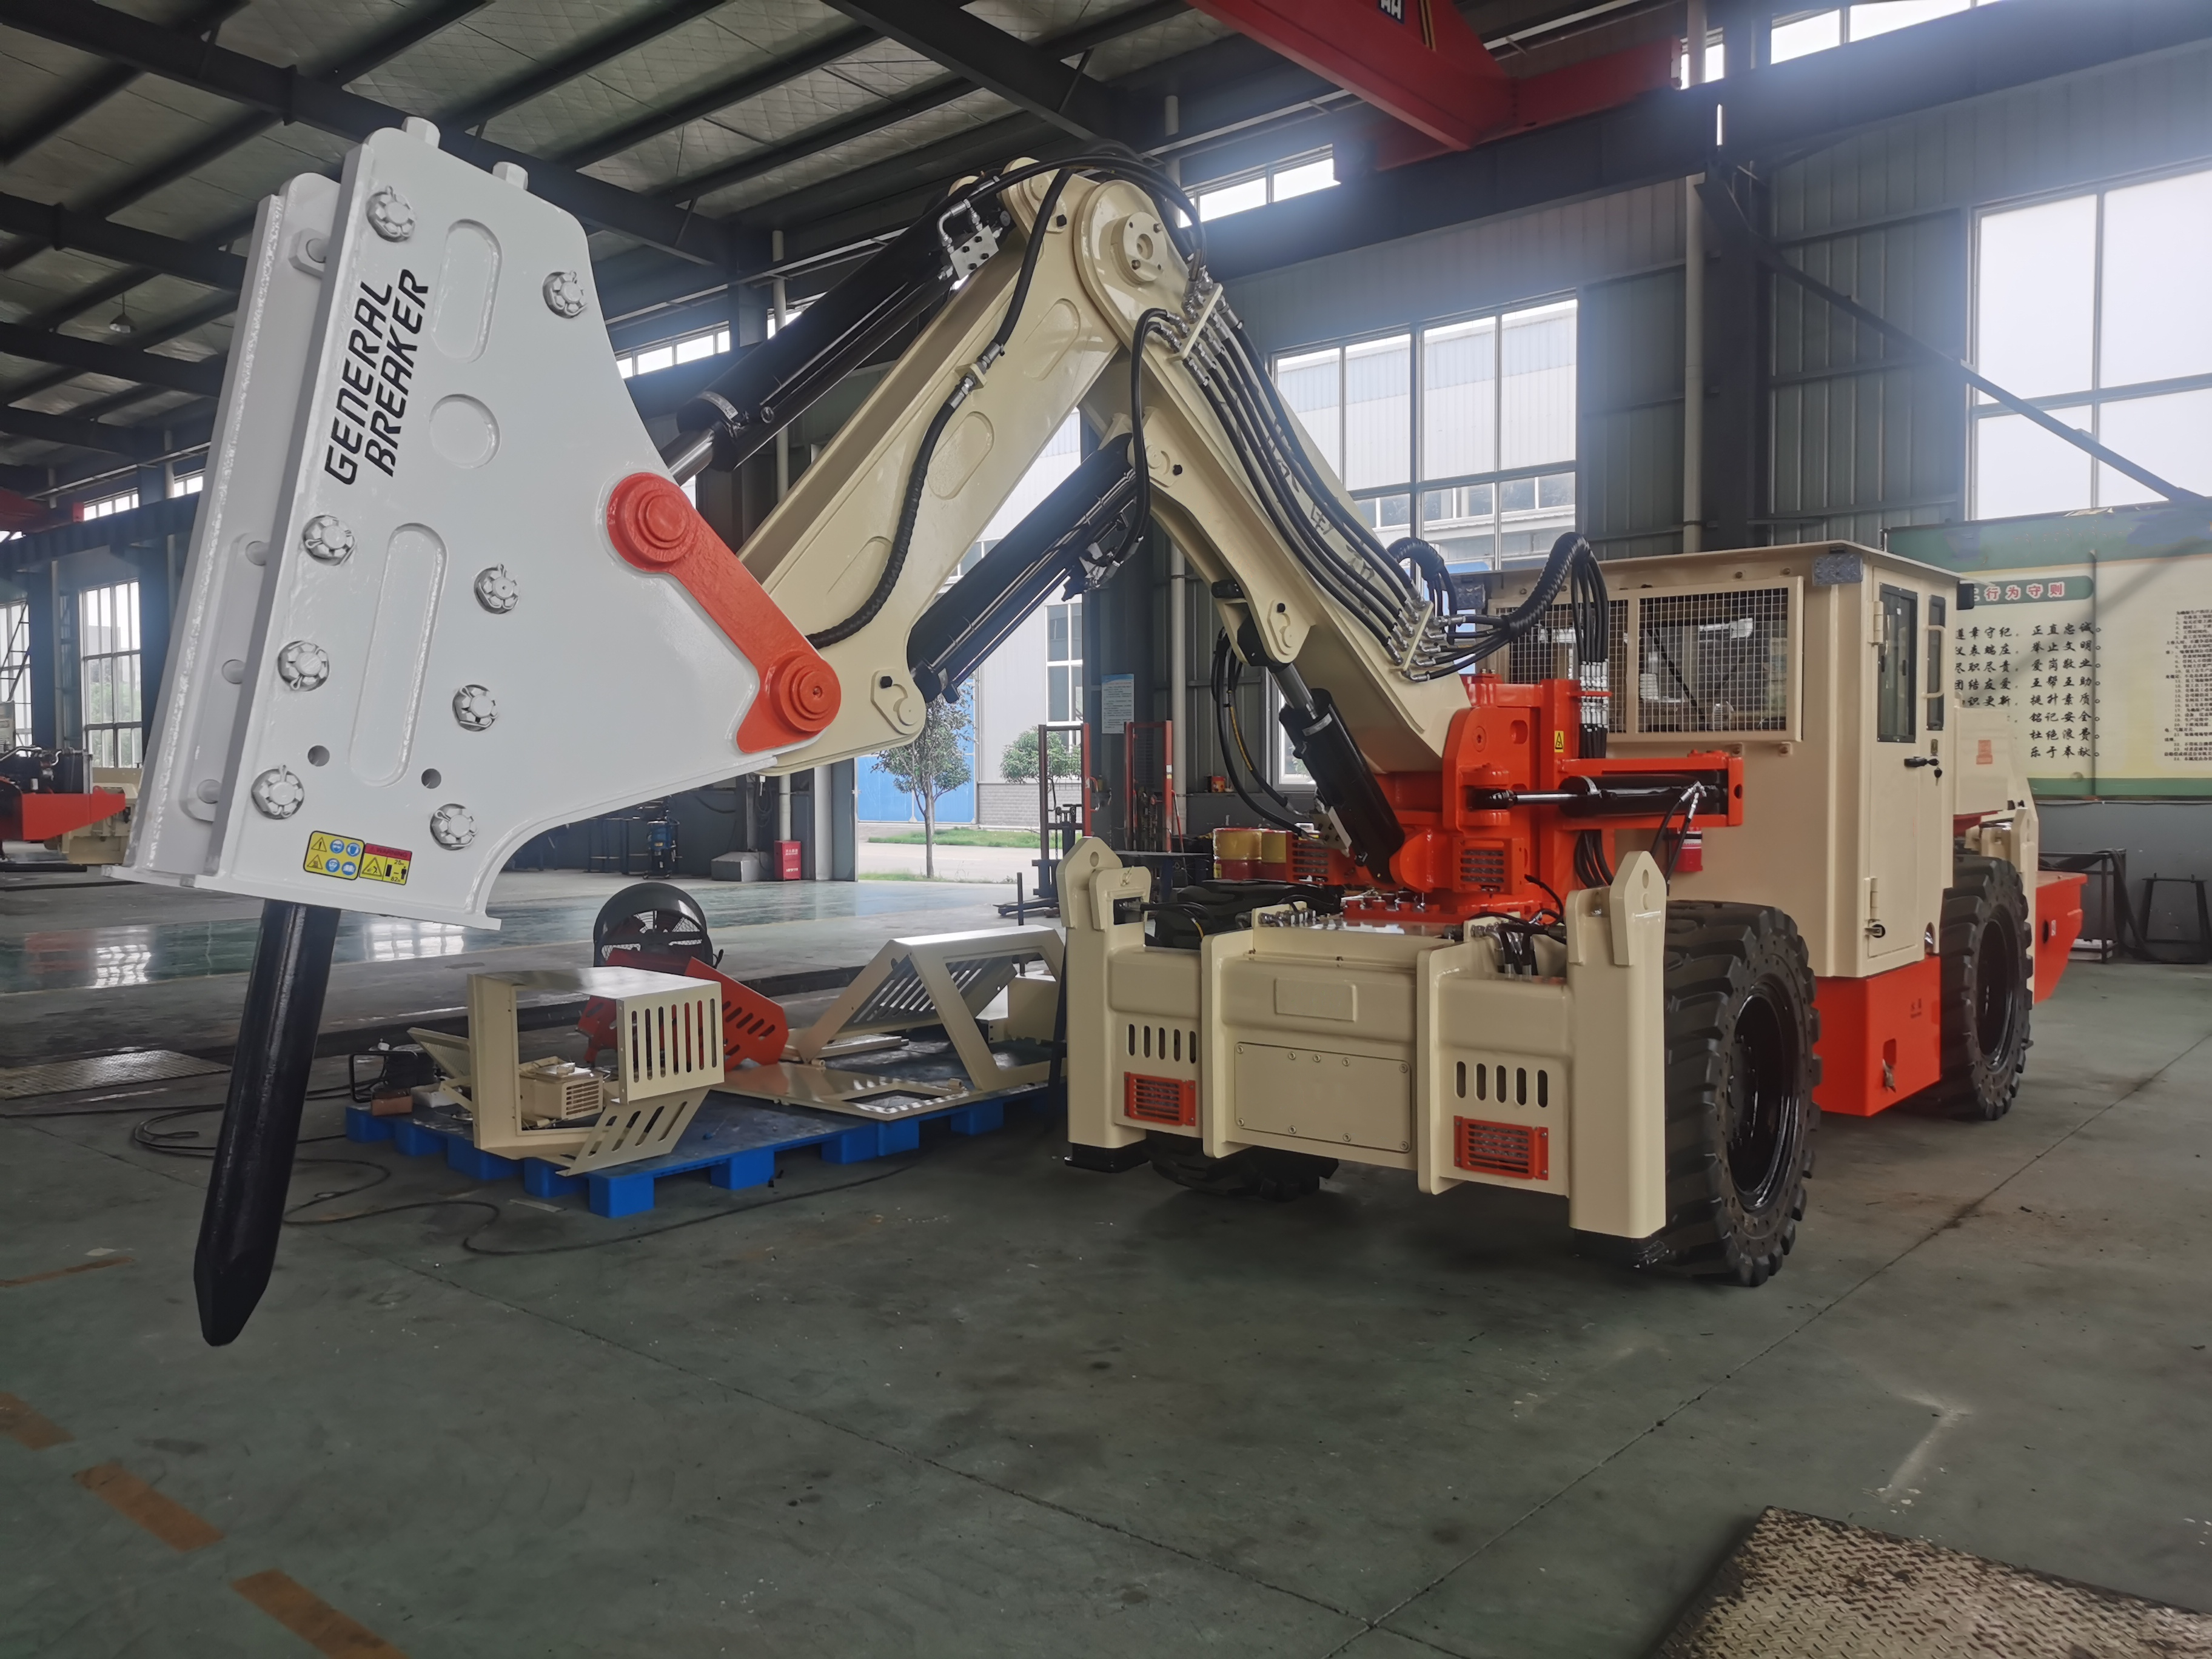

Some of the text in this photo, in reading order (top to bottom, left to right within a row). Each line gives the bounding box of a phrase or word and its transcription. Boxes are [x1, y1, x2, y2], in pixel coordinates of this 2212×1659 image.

[325, 283, 392, 484] GENERAL
[365, 269, 428, 477] BREAKER
[1974, 582, 2065, 601] 行为守则
